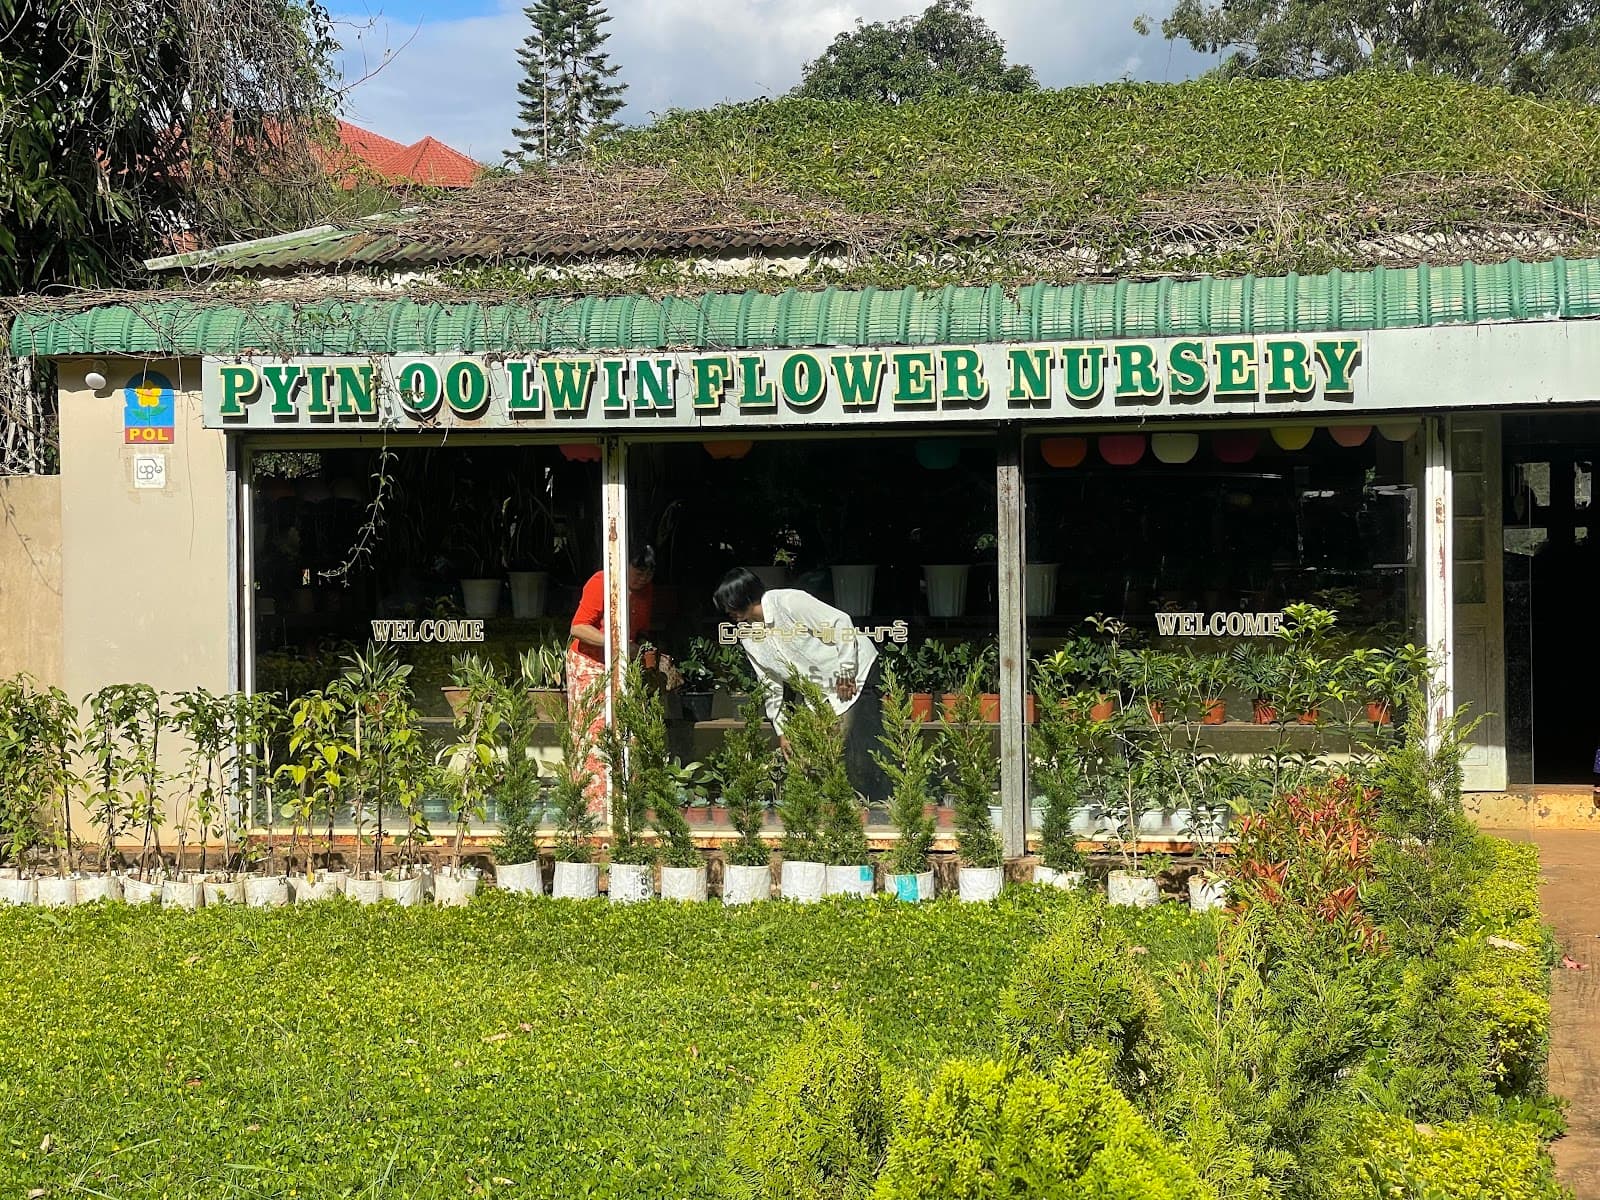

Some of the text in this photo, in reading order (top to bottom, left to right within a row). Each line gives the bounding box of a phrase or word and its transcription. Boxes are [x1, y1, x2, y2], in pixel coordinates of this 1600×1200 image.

[219, 339, 1361, 416] PYIN OO LWIN FLOWER NURSERY
[129, 428, 169, 441] POL
[371, 619, 484, 642] WELCOME
[1155, 612, 1283, 636] WELCOME
